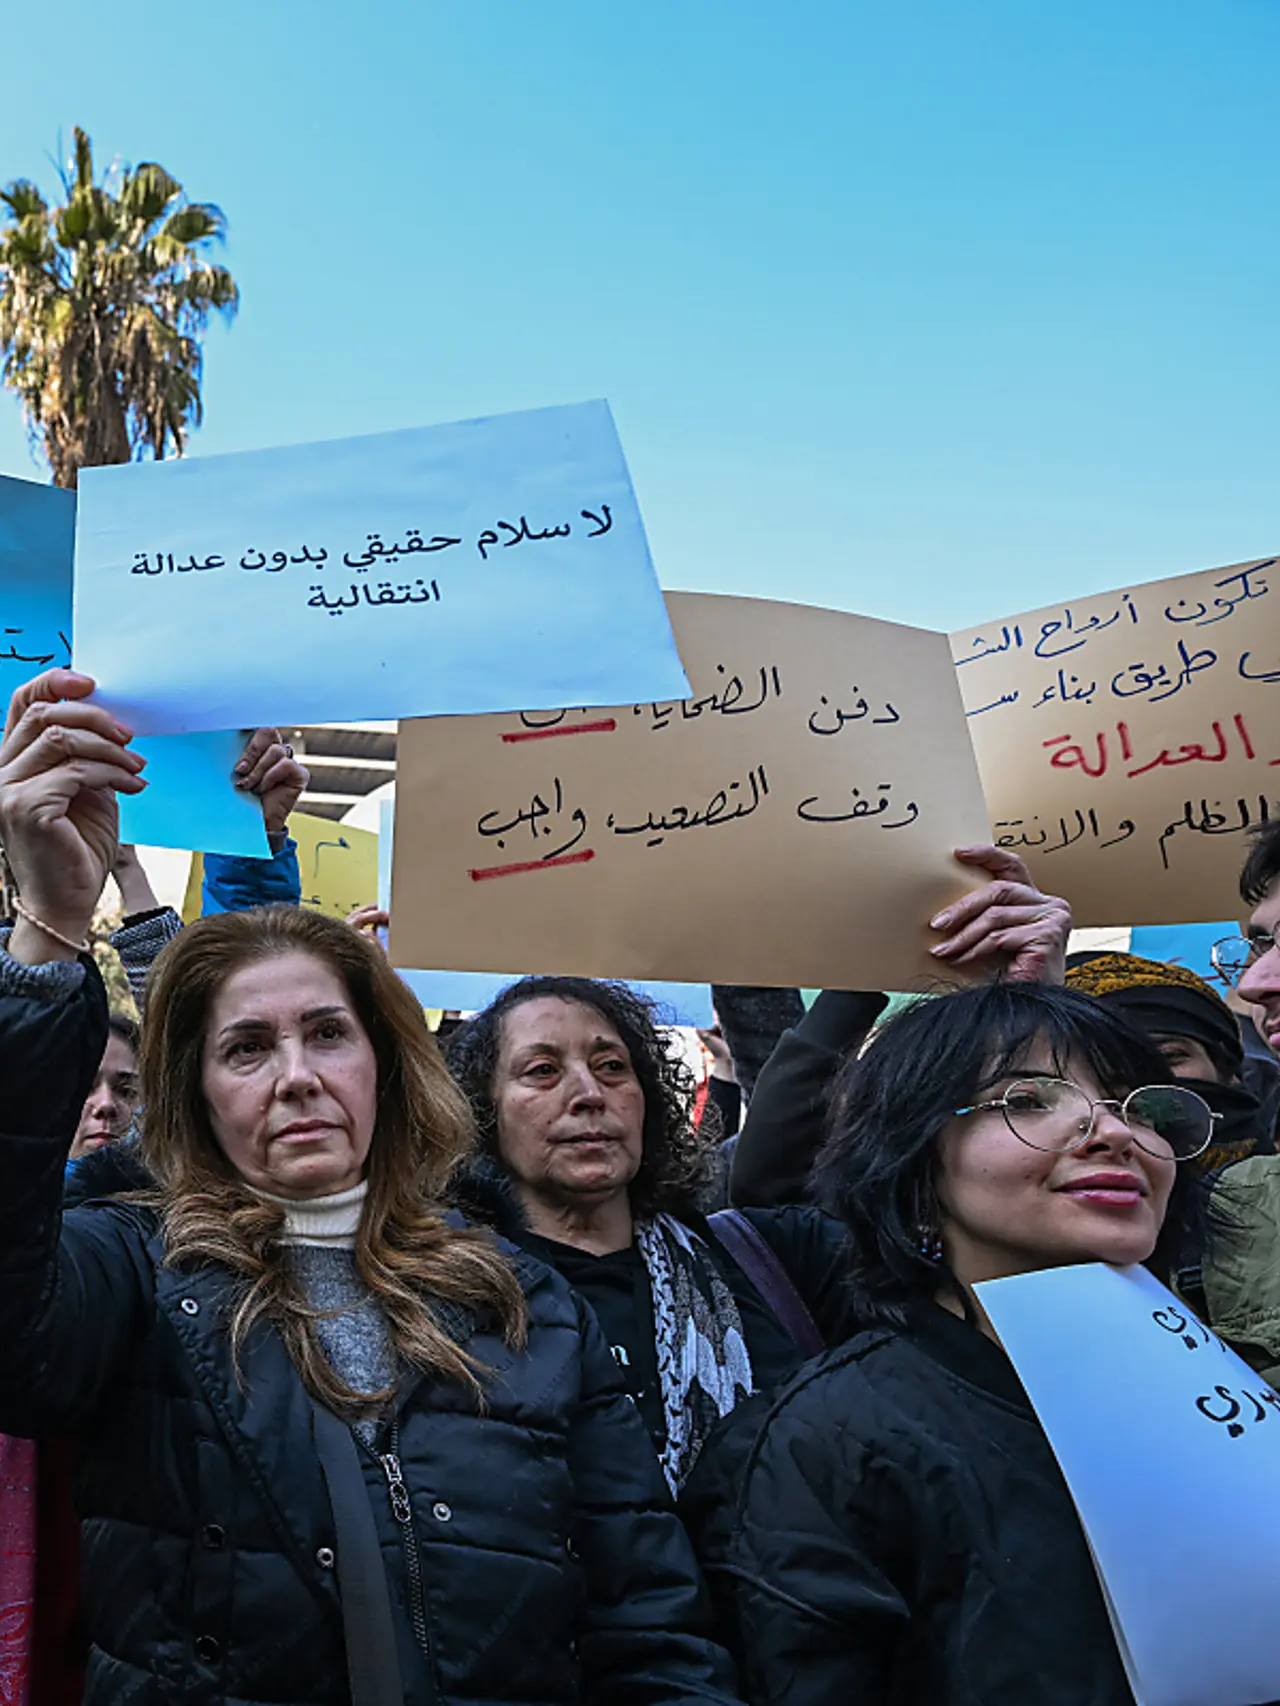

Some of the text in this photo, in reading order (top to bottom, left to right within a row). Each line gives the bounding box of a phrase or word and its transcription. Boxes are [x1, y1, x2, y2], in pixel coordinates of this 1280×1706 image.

[130, 504, 614, 576] لا سلام حقيقي بدون عدالة
[306, 578, 442, 617] انتقالية
[1164, 559, 1277, 626] تكون
[954, 625, 1023, 666] الش
[1109, 637, 1218, 705] طريق
[808, 682, 900, 737] دفن
[1030, 669, 1099, 710] بناء
[1042, 712, 1256, 778] العدالة
[476, 776, 587, 861] واجب
[796, 783, 919, 829] وقف
